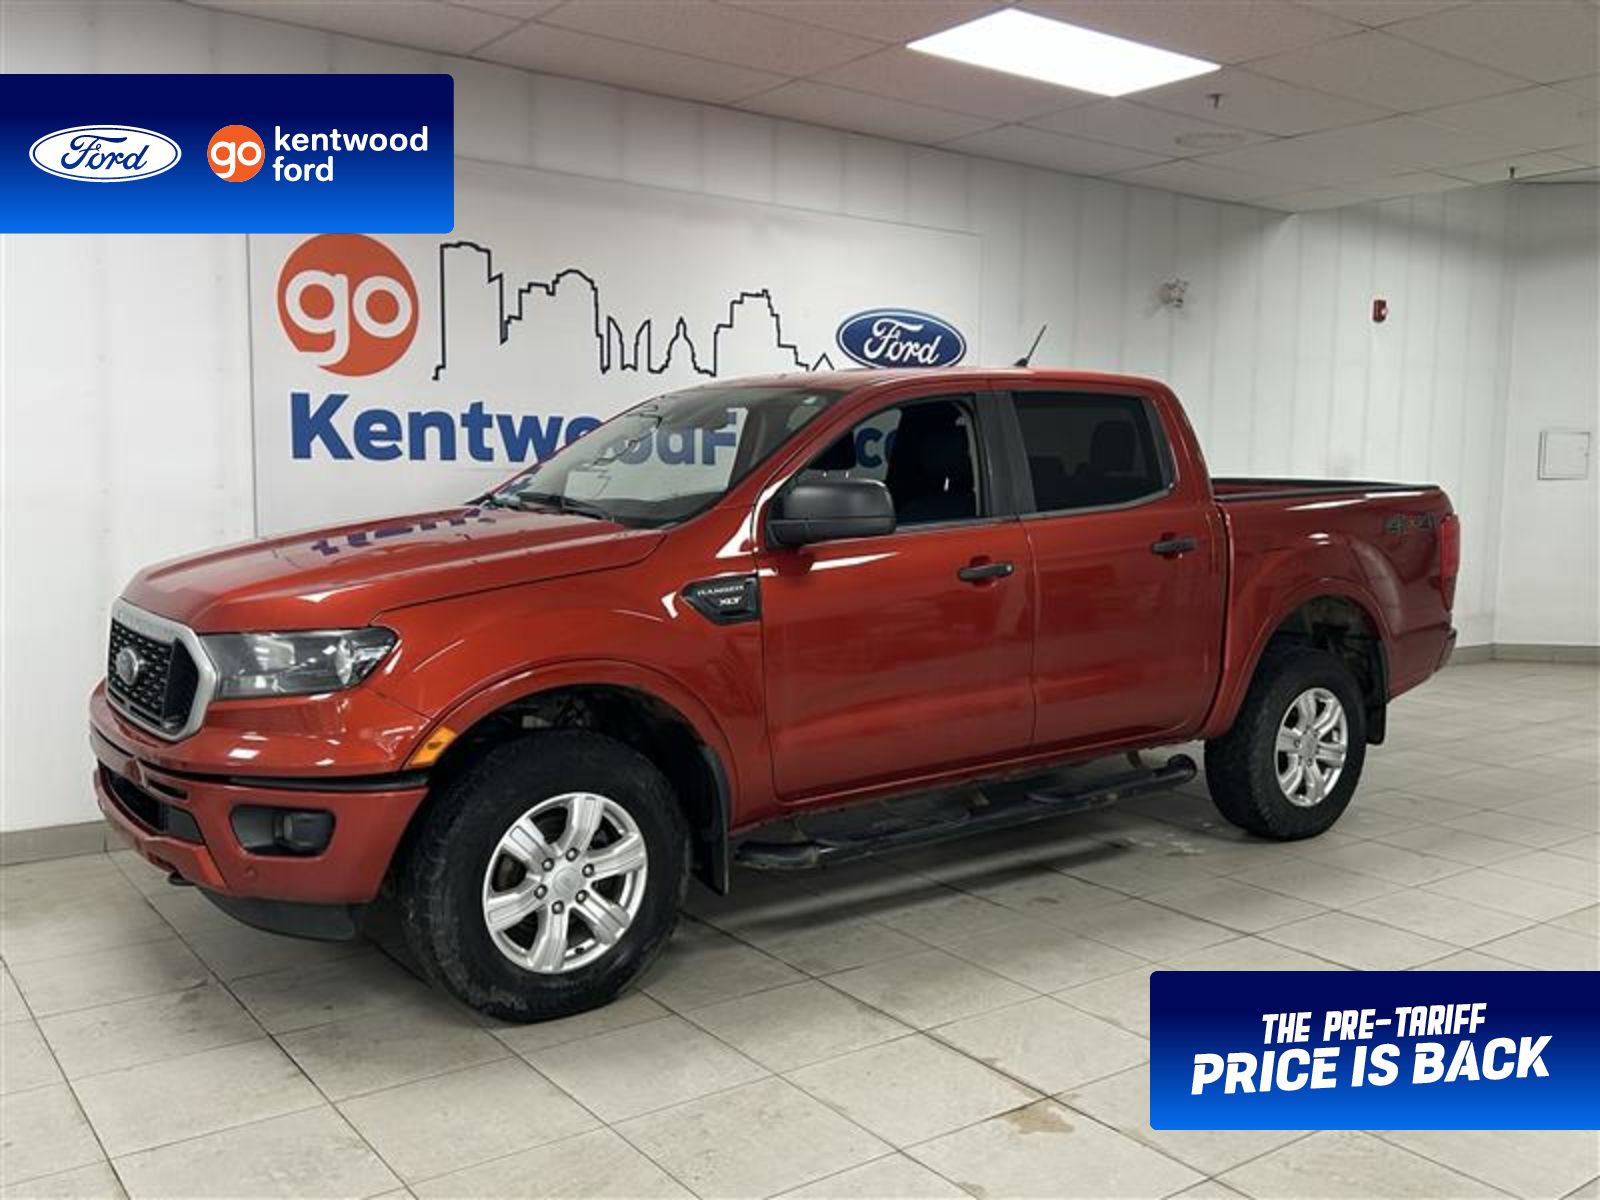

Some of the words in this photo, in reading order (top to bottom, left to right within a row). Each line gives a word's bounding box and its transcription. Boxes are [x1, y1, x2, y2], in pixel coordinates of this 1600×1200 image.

[285, 269, 413, 368] go
[863, 318, 942, 365] Ford
[697, 584, 744, 597] RANGER
[719, 595, 742, 607] XLT
